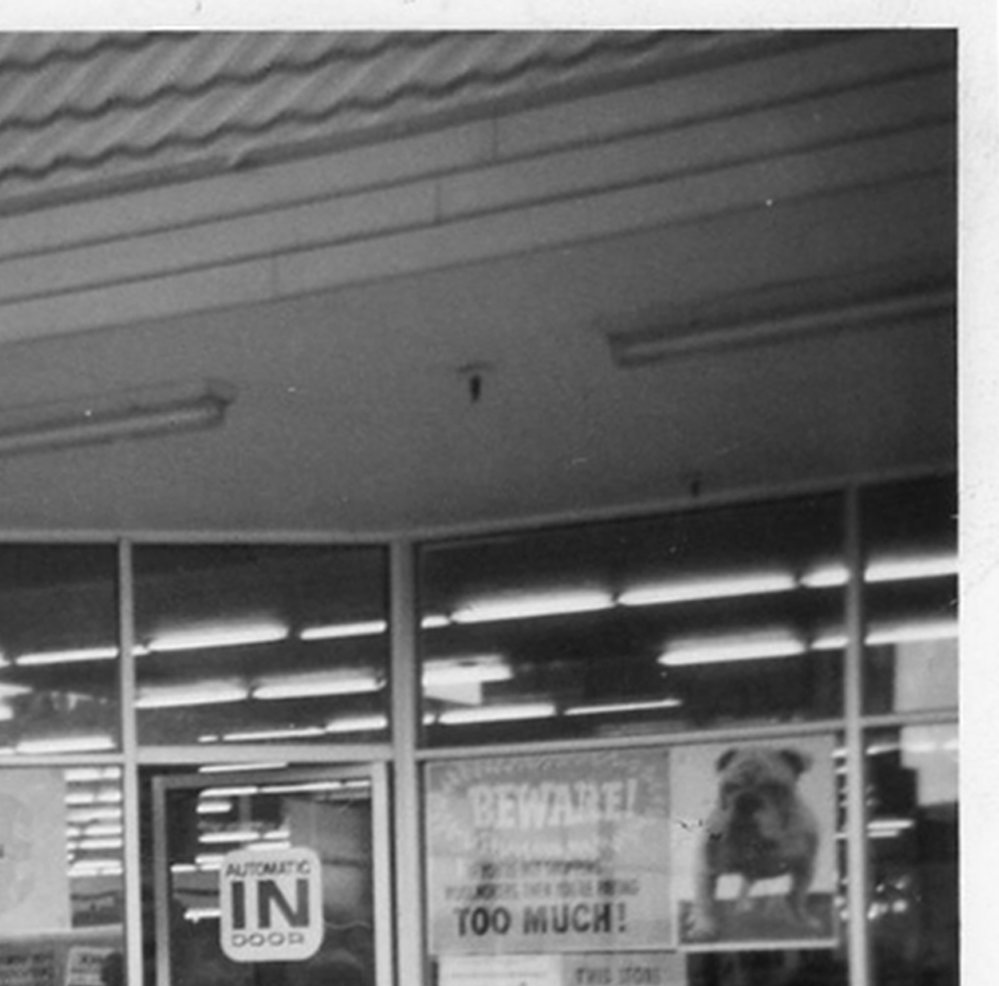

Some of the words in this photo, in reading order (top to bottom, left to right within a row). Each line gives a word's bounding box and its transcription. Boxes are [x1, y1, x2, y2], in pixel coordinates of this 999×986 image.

[467, 778, 637, 828] BEWARE!
[226, 860, 311, 878] AUTOMATIC
[231, 879, 310, 929] IN
[453, 906, 511, 937] TOO
[523, 902, 627, 934] MUCH!
[231, 931, 305, 948] DOOR
